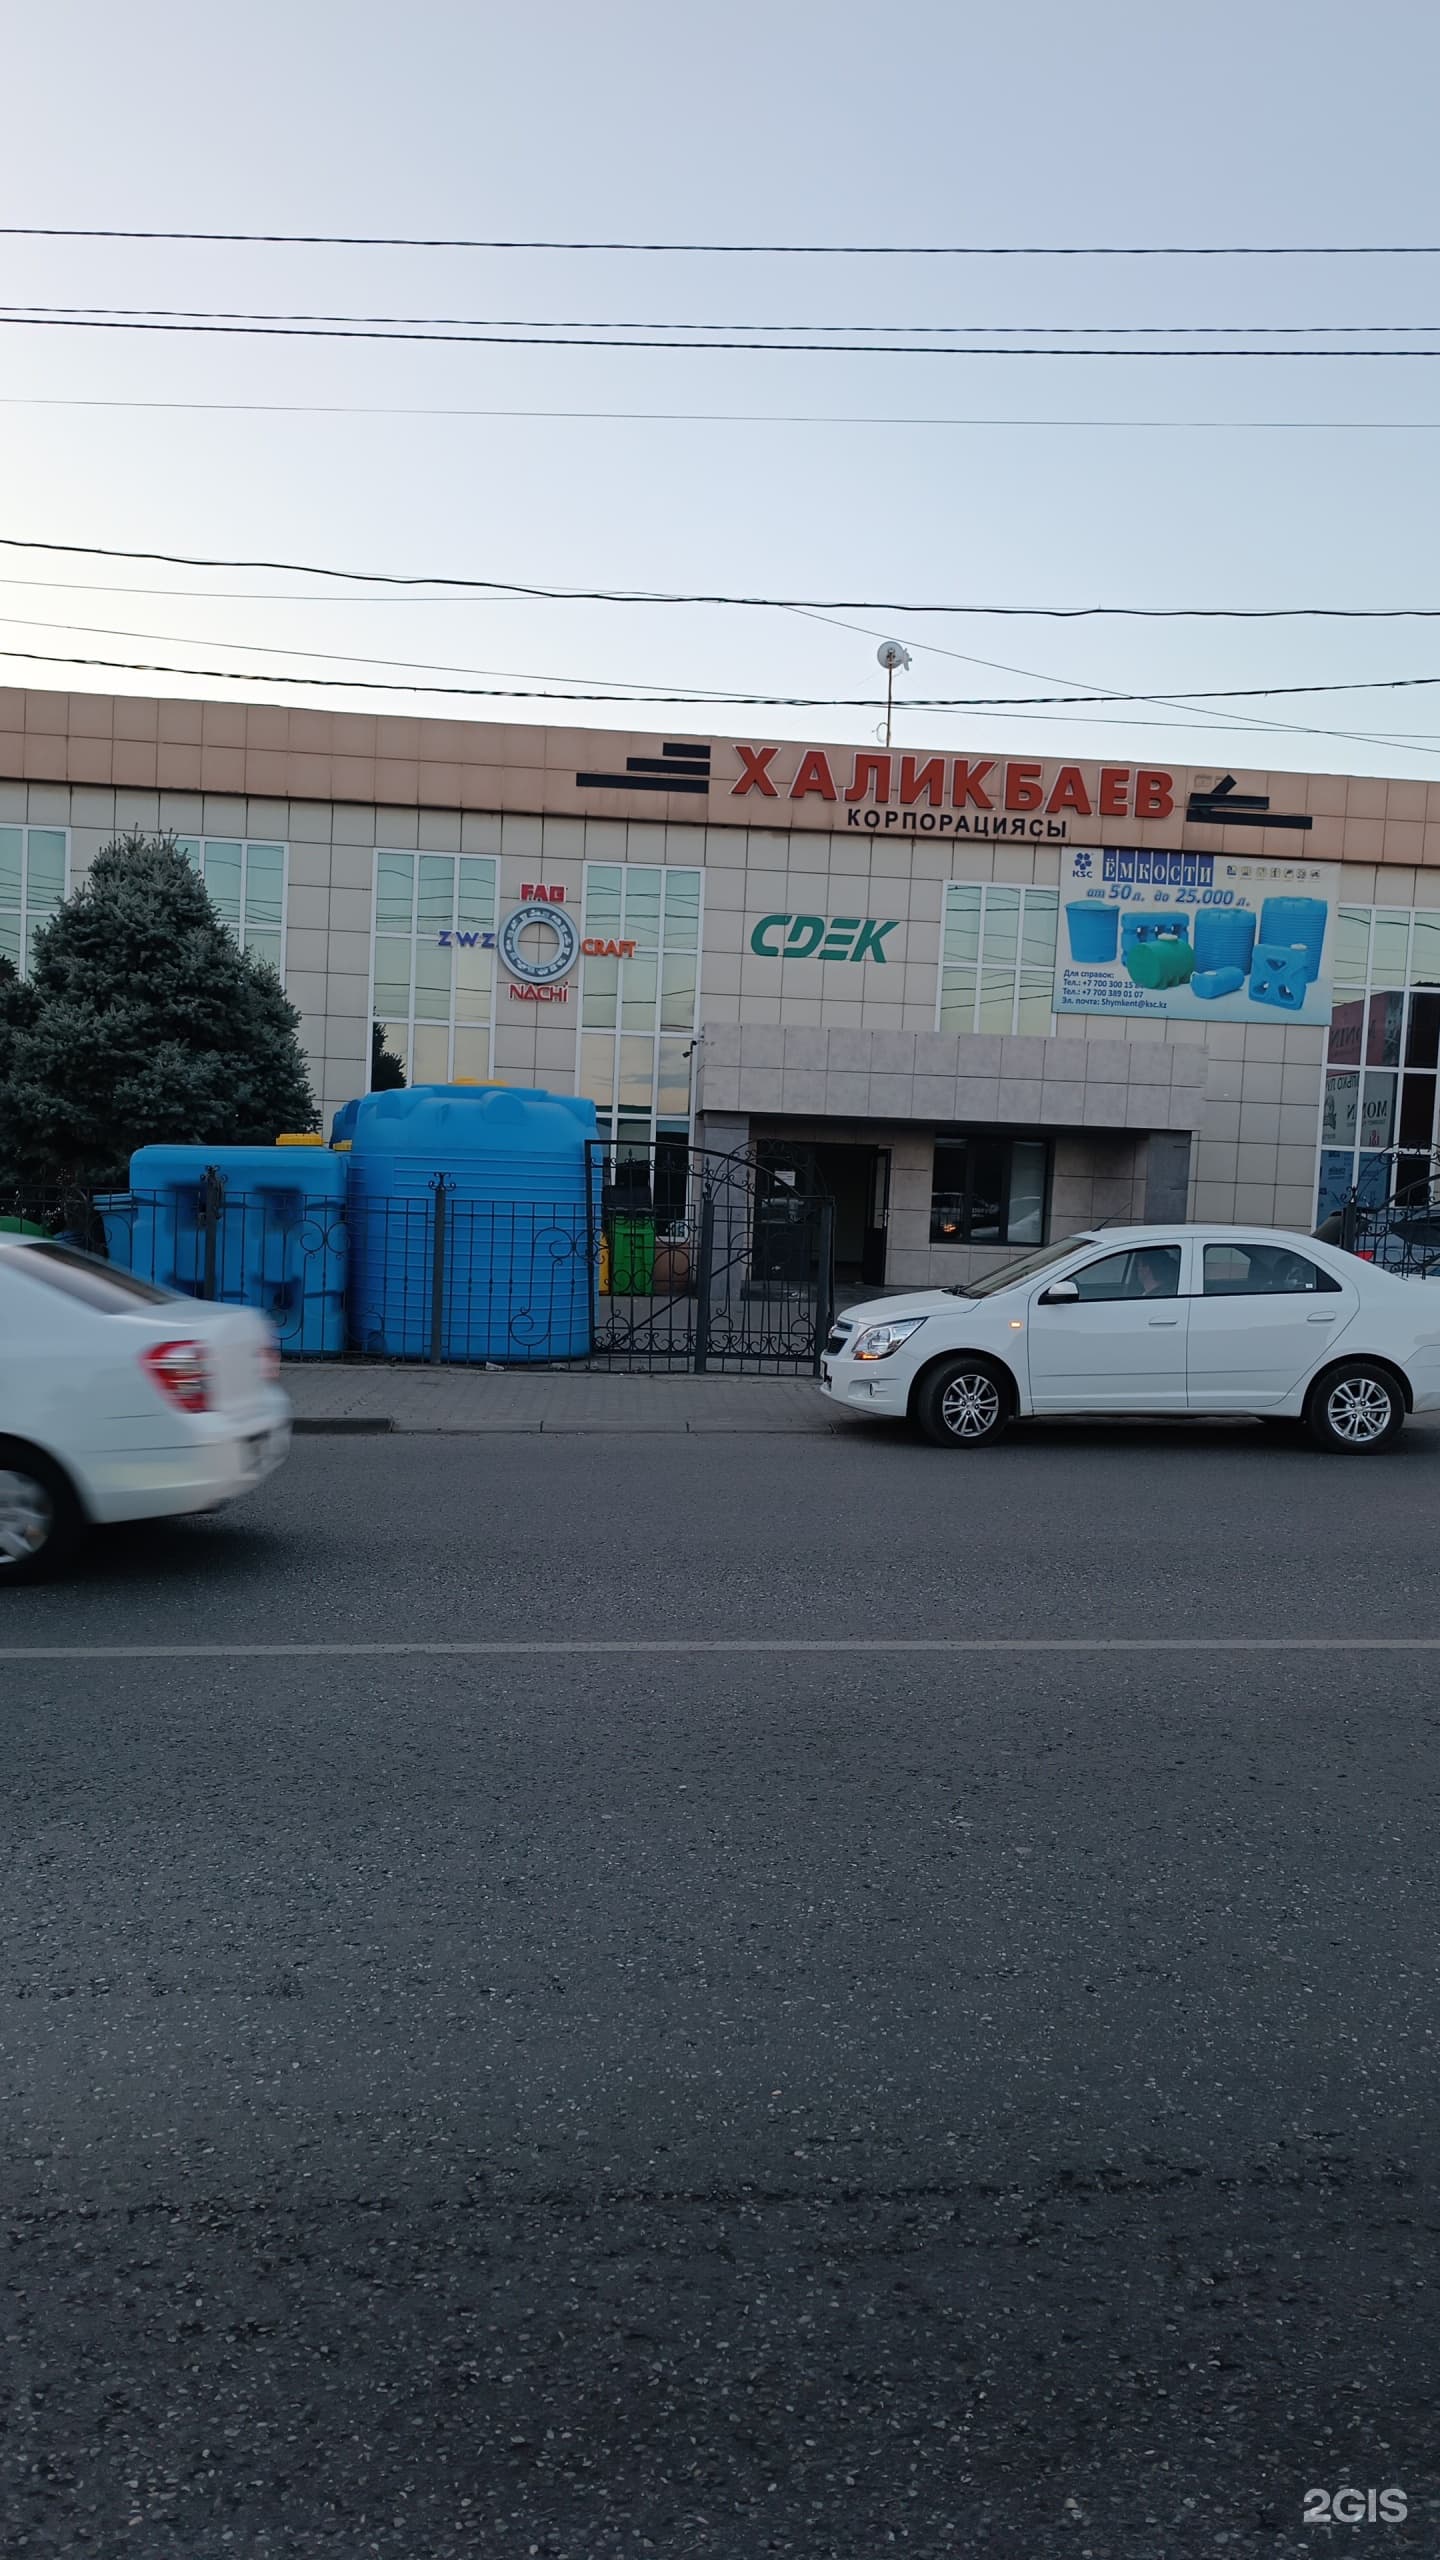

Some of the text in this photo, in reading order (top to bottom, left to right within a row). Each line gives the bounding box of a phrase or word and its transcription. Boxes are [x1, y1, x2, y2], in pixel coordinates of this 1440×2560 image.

[730, 744, 1175, 819] ХАЛИКБАЕВ
[846, 808, 1067, 838] КОРПОРАЦИЯСЫ
[1072, 870, 1093, 878] KSC
[1104, 857, 1212, 885] ЁМКОСТИ
[1108, 884, 1132, 900] 50
[1154, 889, 1170, 902] до
[1175, 888, 1234, 906] 25.000
[438, 930, 496, 948] ZWZ
[581, 938, 637, 958] CRAFT
[750, 914, 900, 964] CDEK
[1064, 969, 1114, 979] Для справок:
